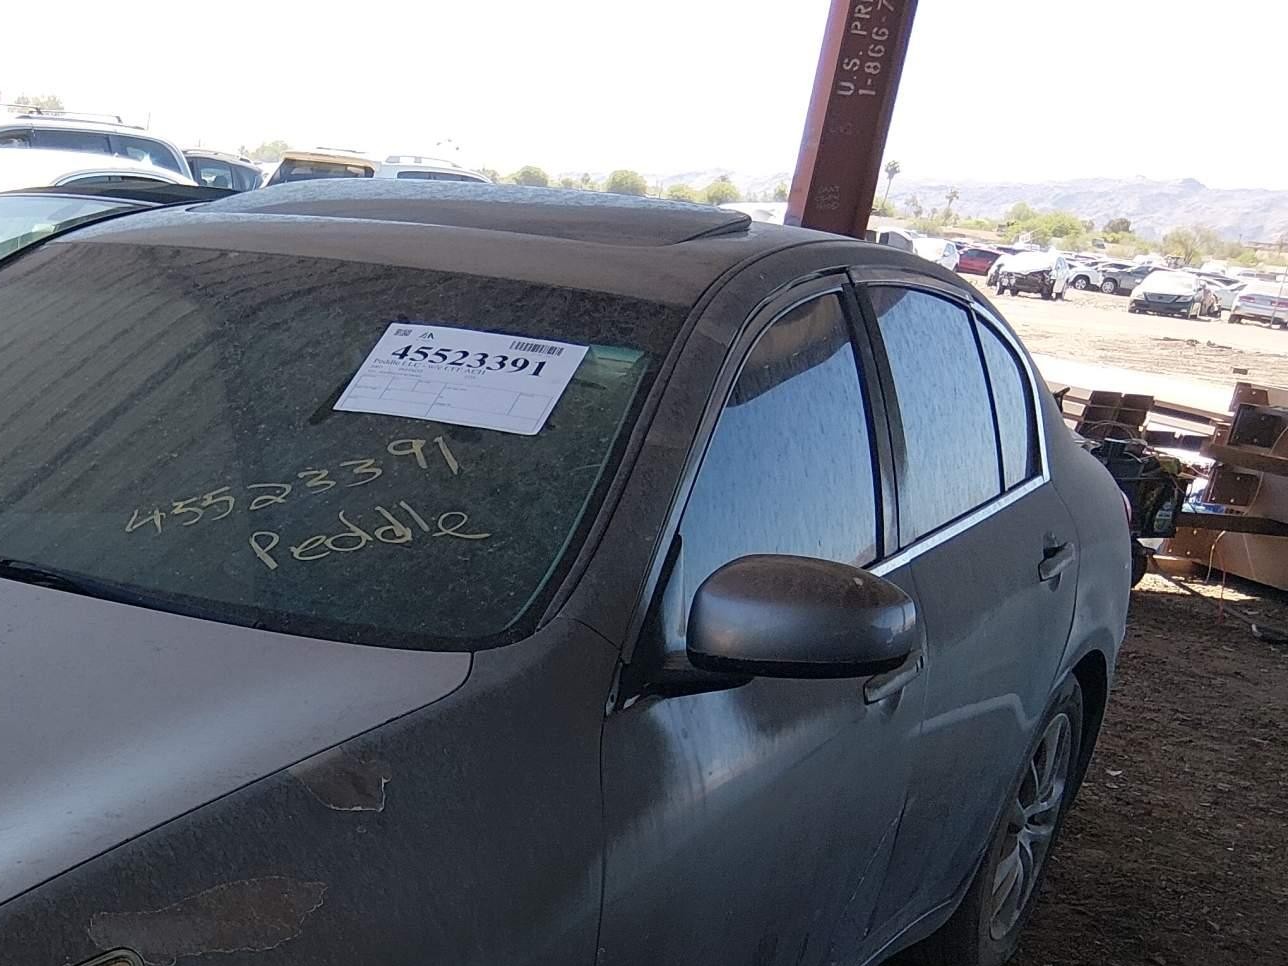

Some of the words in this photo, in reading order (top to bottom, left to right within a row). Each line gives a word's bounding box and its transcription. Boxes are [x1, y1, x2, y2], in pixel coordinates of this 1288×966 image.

[837, 49, 863, 96] U.S.
[391, 344, 547, 377] 45523391
[124, 436, 459, 534] 45523391
[249, 500, 491, 570] Peddle
